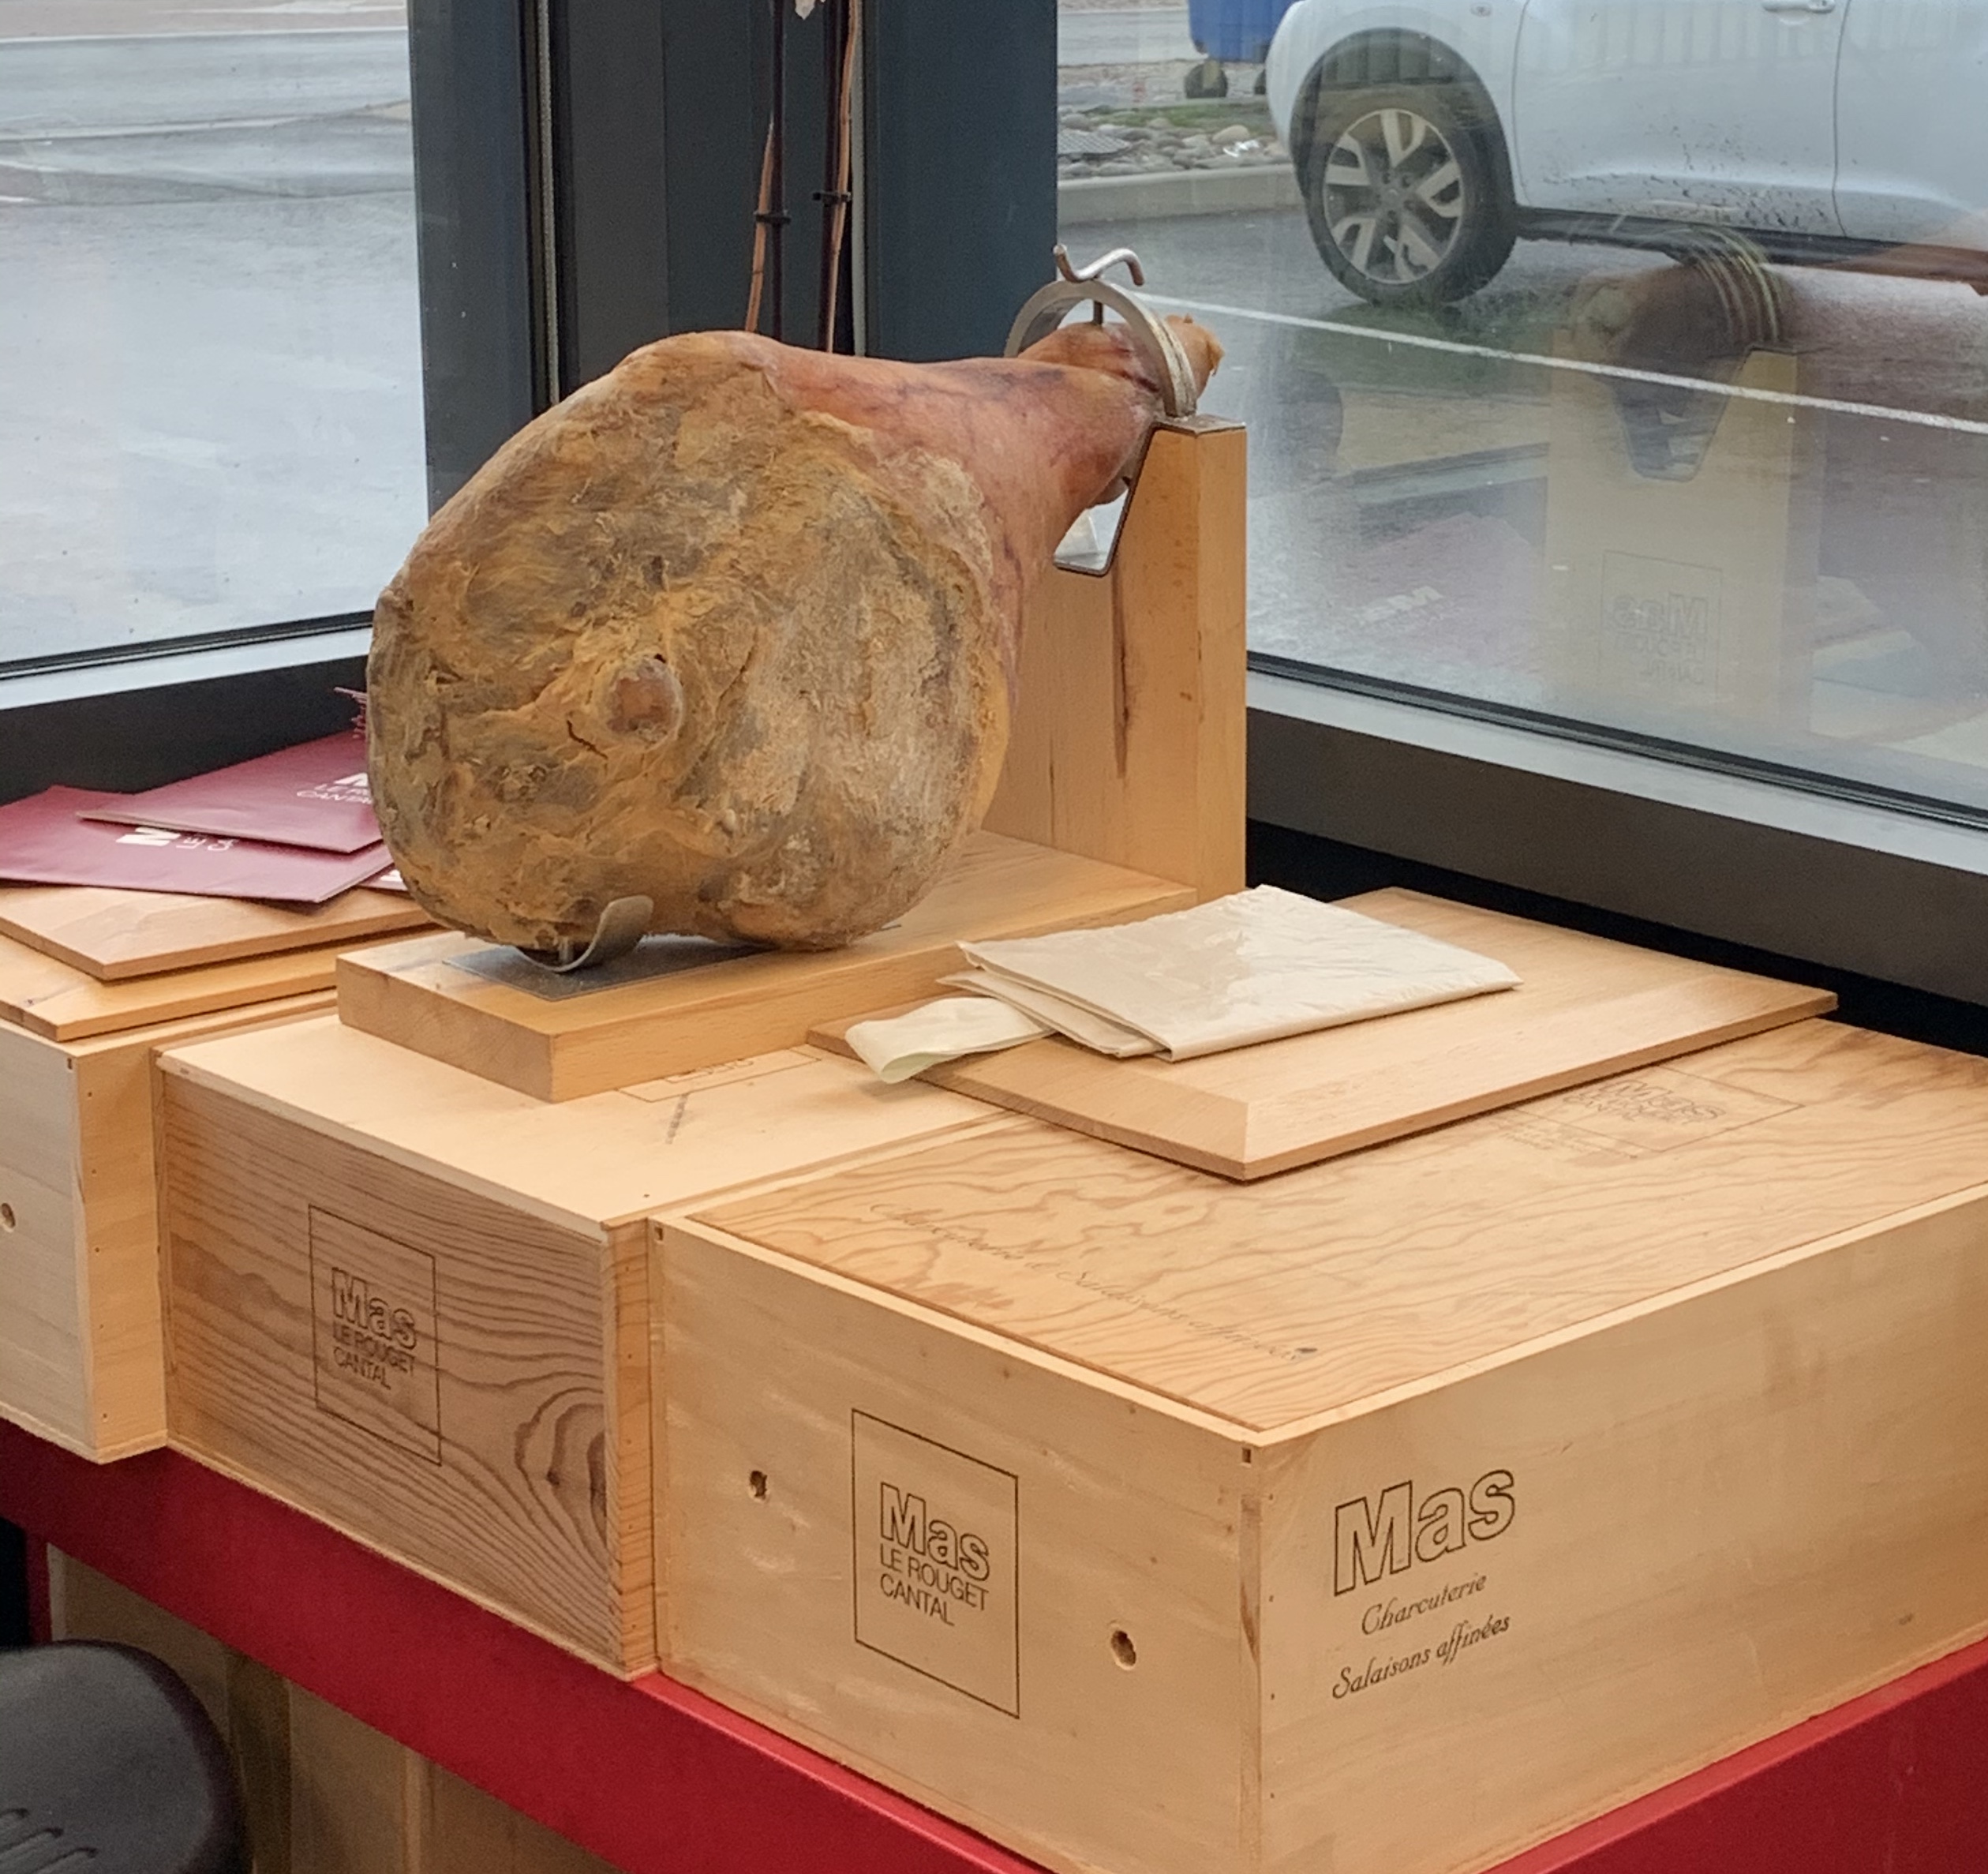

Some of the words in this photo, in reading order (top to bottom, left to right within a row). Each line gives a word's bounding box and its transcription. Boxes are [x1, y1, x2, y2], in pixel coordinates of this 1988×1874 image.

[297, 789, 373, 804] CANTA
[331, 1266, 417, 1351] Mas
[332, 1319, 353, 1347] LE
[355, 1331, 416, 1377] ROUGET
[332, 1345, 392, 1391] CANTAL
[880, 1481, 990, 1582] Mas
[1335, 1468, 1515, 1598] Mas
[880, 1542, 904, 1574] LE
[908, 1555, 990, 1612] ROUGET
[880, 1572, 956, 1627] CANTAL
[1361, 1572, 1487, 1636] Charcuterie
[1332, 1647, 1432, 1700] Salaisons
[1436, 1613, 1511, 1667] affinées
